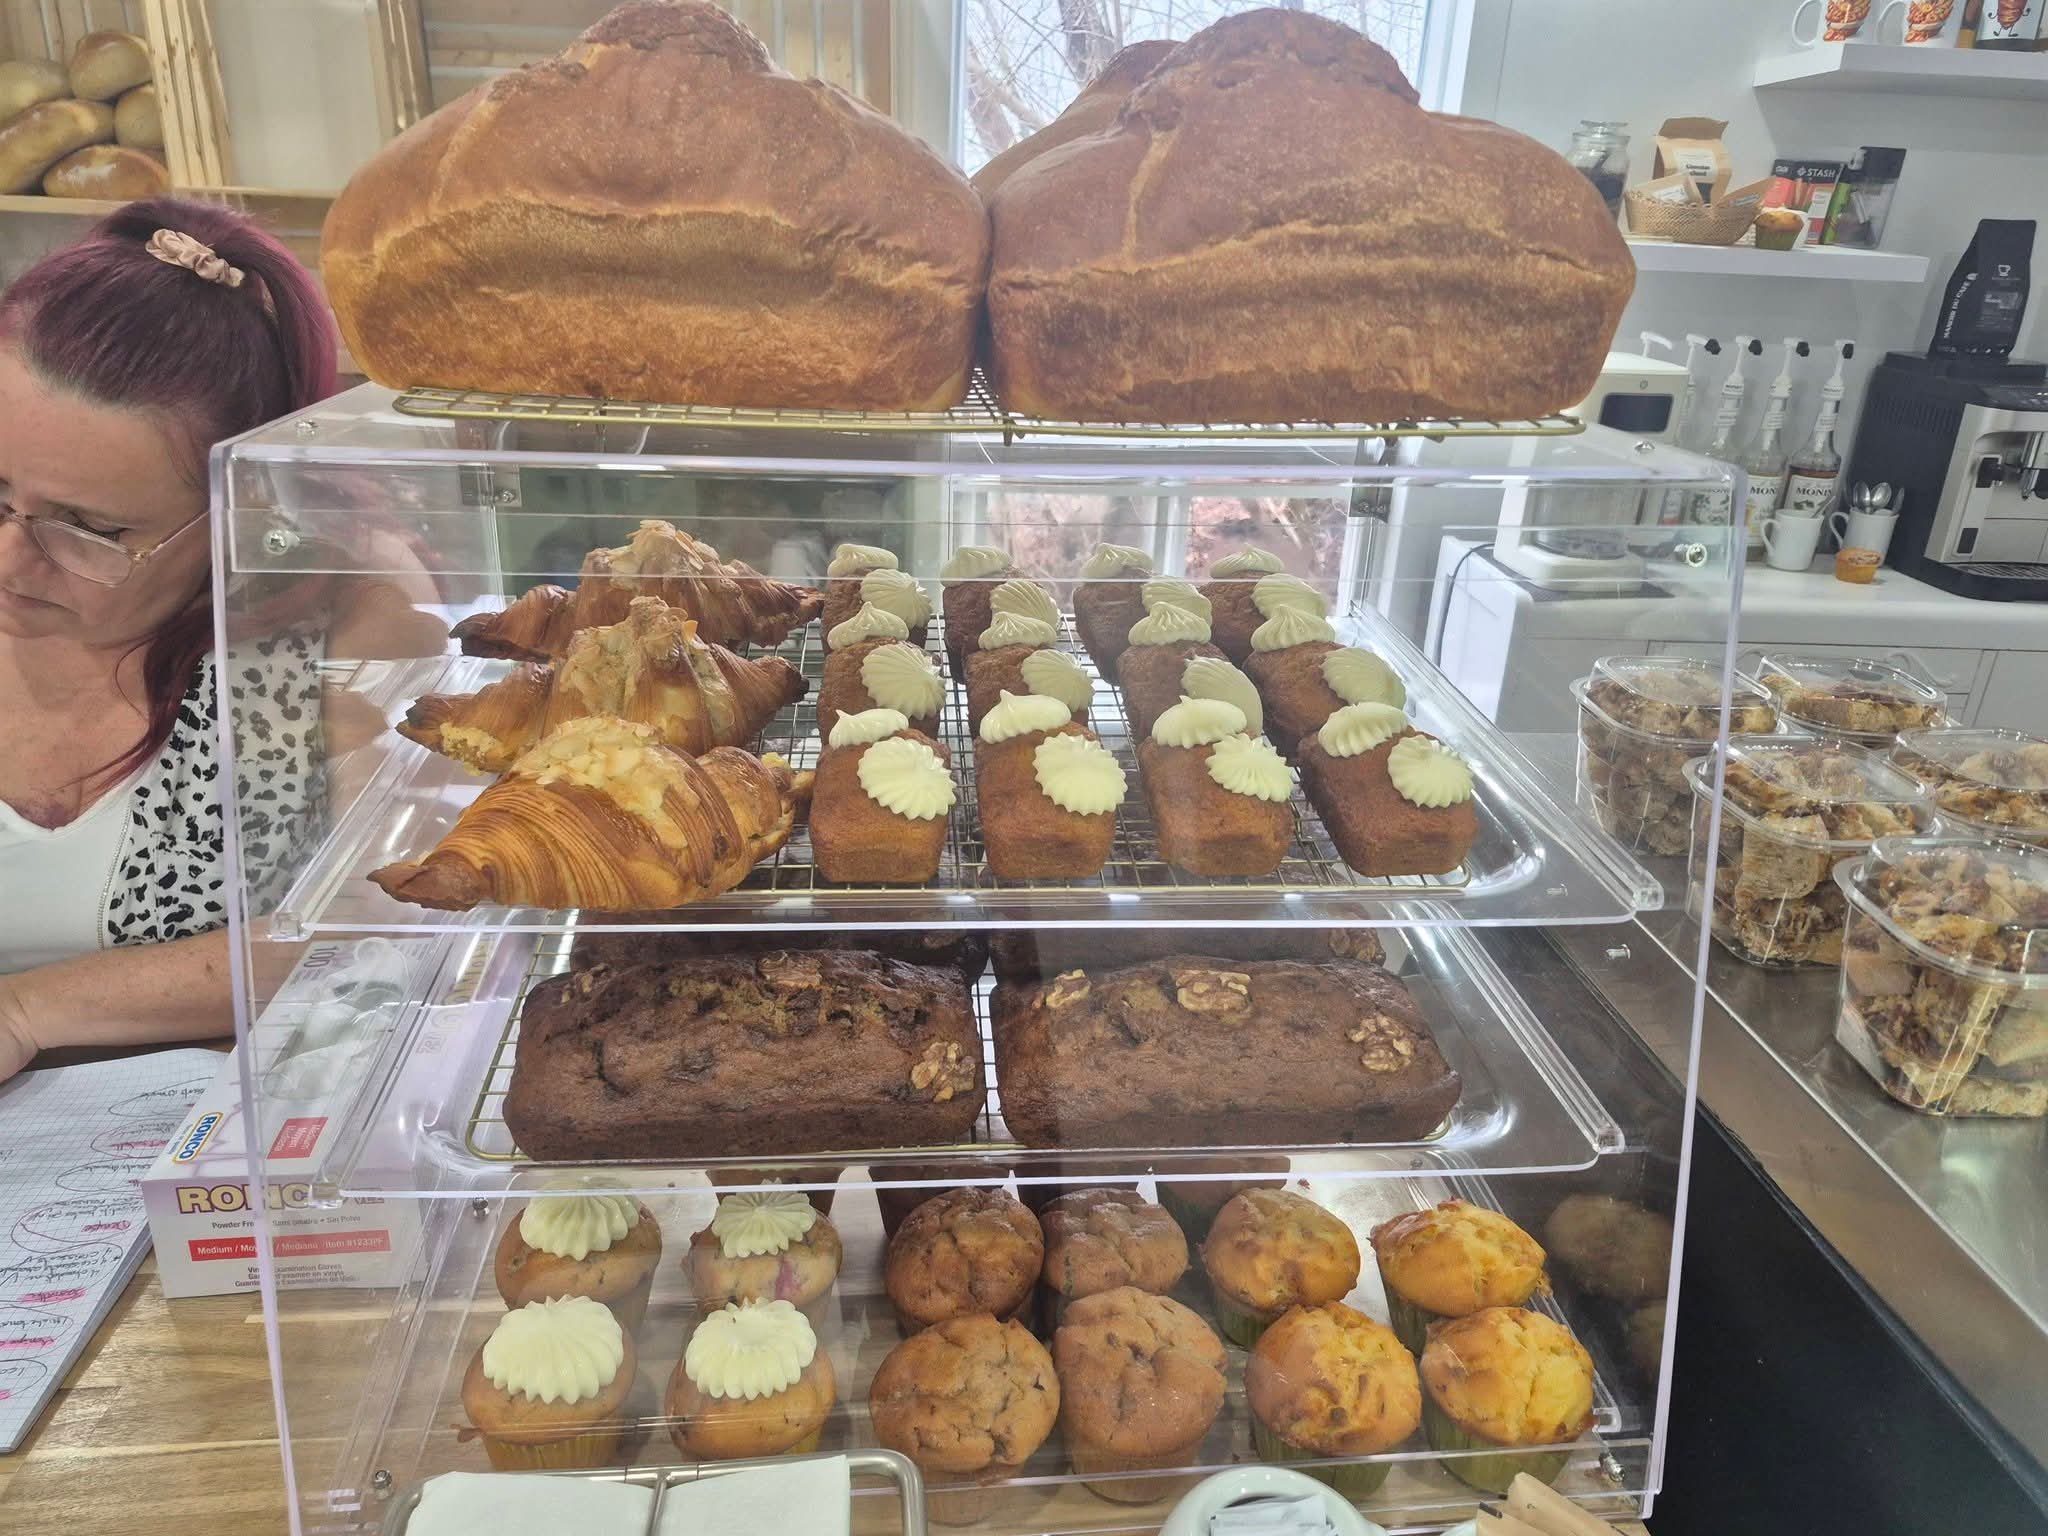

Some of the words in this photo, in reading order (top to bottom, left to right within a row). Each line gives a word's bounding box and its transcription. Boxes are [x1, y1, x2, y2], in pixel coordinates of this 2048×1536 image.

[1806, 167, 1837, 178] STASH
[303, 945, 339, 969] 100
[178, 1115, 218, 1160] RONCO
[176, 1183, 325, 1214] RONC
[211, 1220, 241, 1230] Powder
[197, 1245, 233, 1256] Medium
[235, 1280, 260, 1288] Guante
